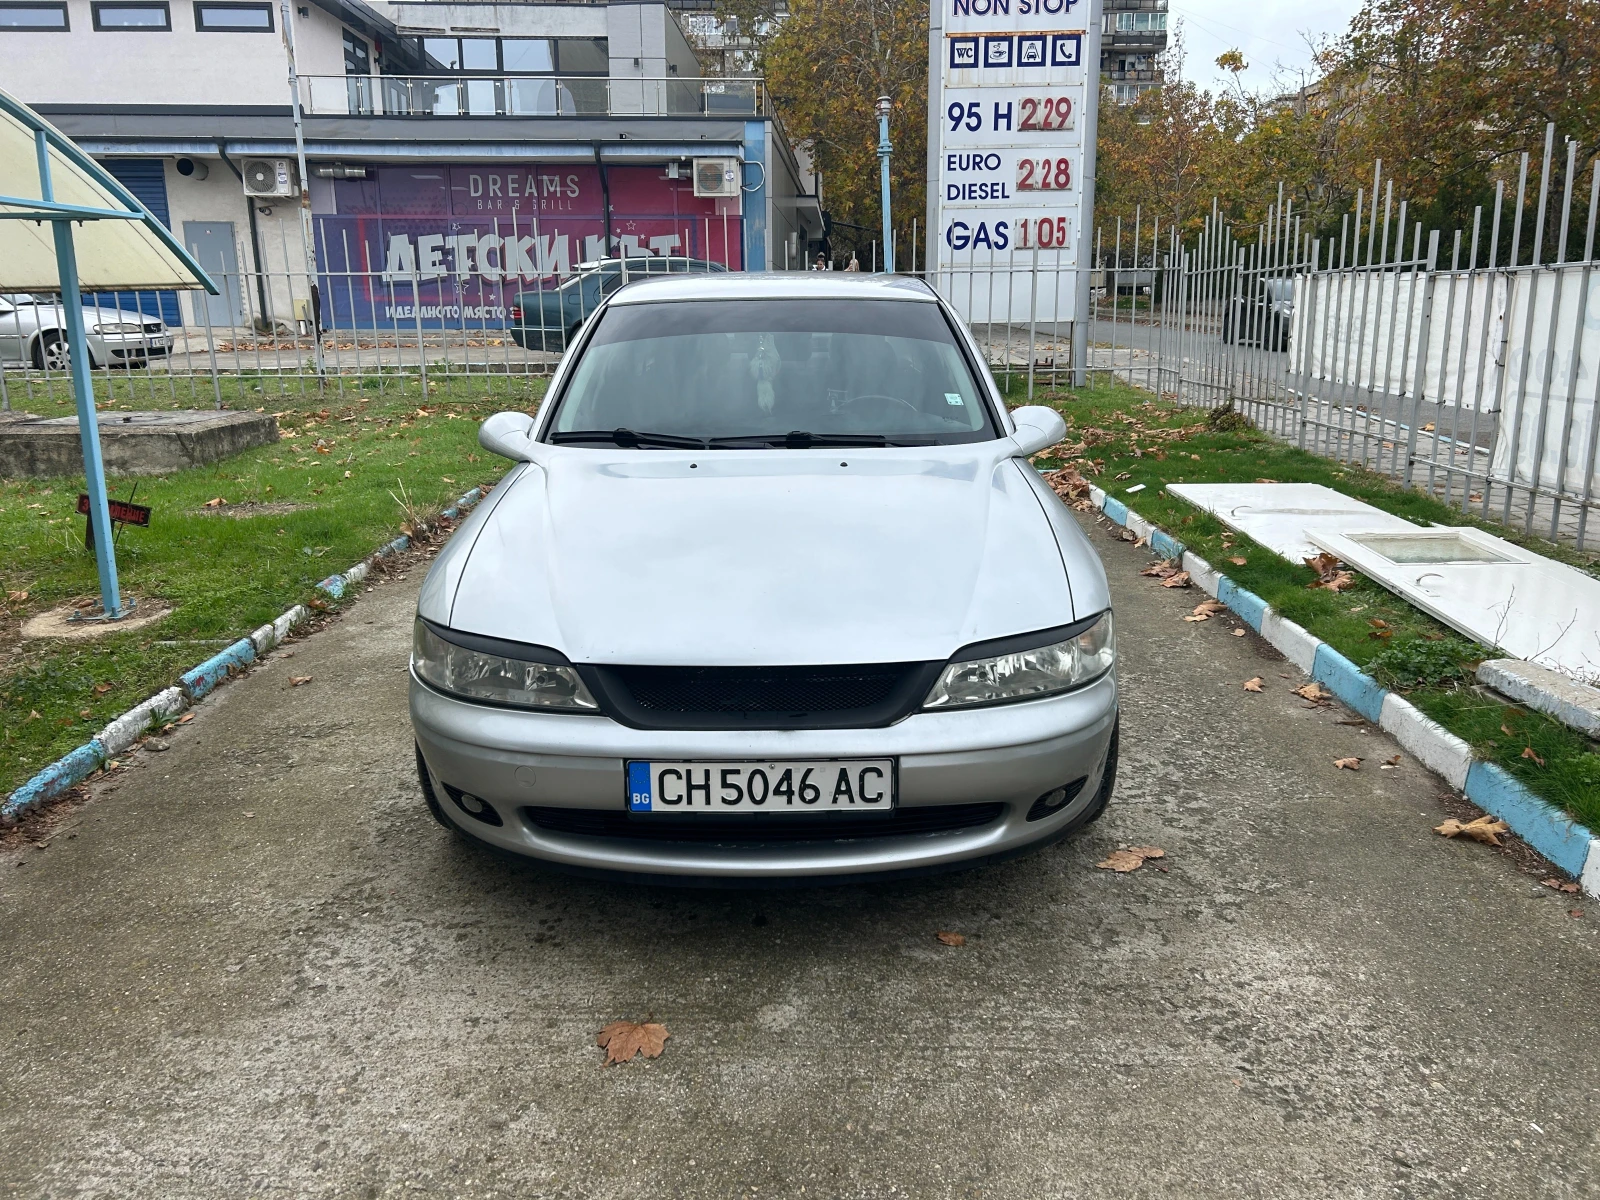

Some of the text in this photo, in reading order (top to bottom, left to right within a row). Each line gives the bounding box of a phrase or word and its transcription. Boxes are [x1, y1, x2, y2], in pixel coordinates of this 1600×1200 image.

[953, 0, 1079, 16] NON STOP
[956, 47, 973, 59] WC
[948, 102, 982, 132] 95
[993, 102, 1013, 131] H
[947, 153, 1001, 172] EURO
[469, 174, 580, 198] DREAMS
[947, 182, 1010, 201] DIESEL
[477, 199, 502, 210] BAR
[532, 199, 573, 211] GRILL
[946, 221, 1009, 250] GAS
[381, 233, 571, 282] ДЕТСКИ
[463, 305, 507, 319] МЯСТО
[720, 768, 821, 806] 5046
[632, 793, 650, 804] BG
